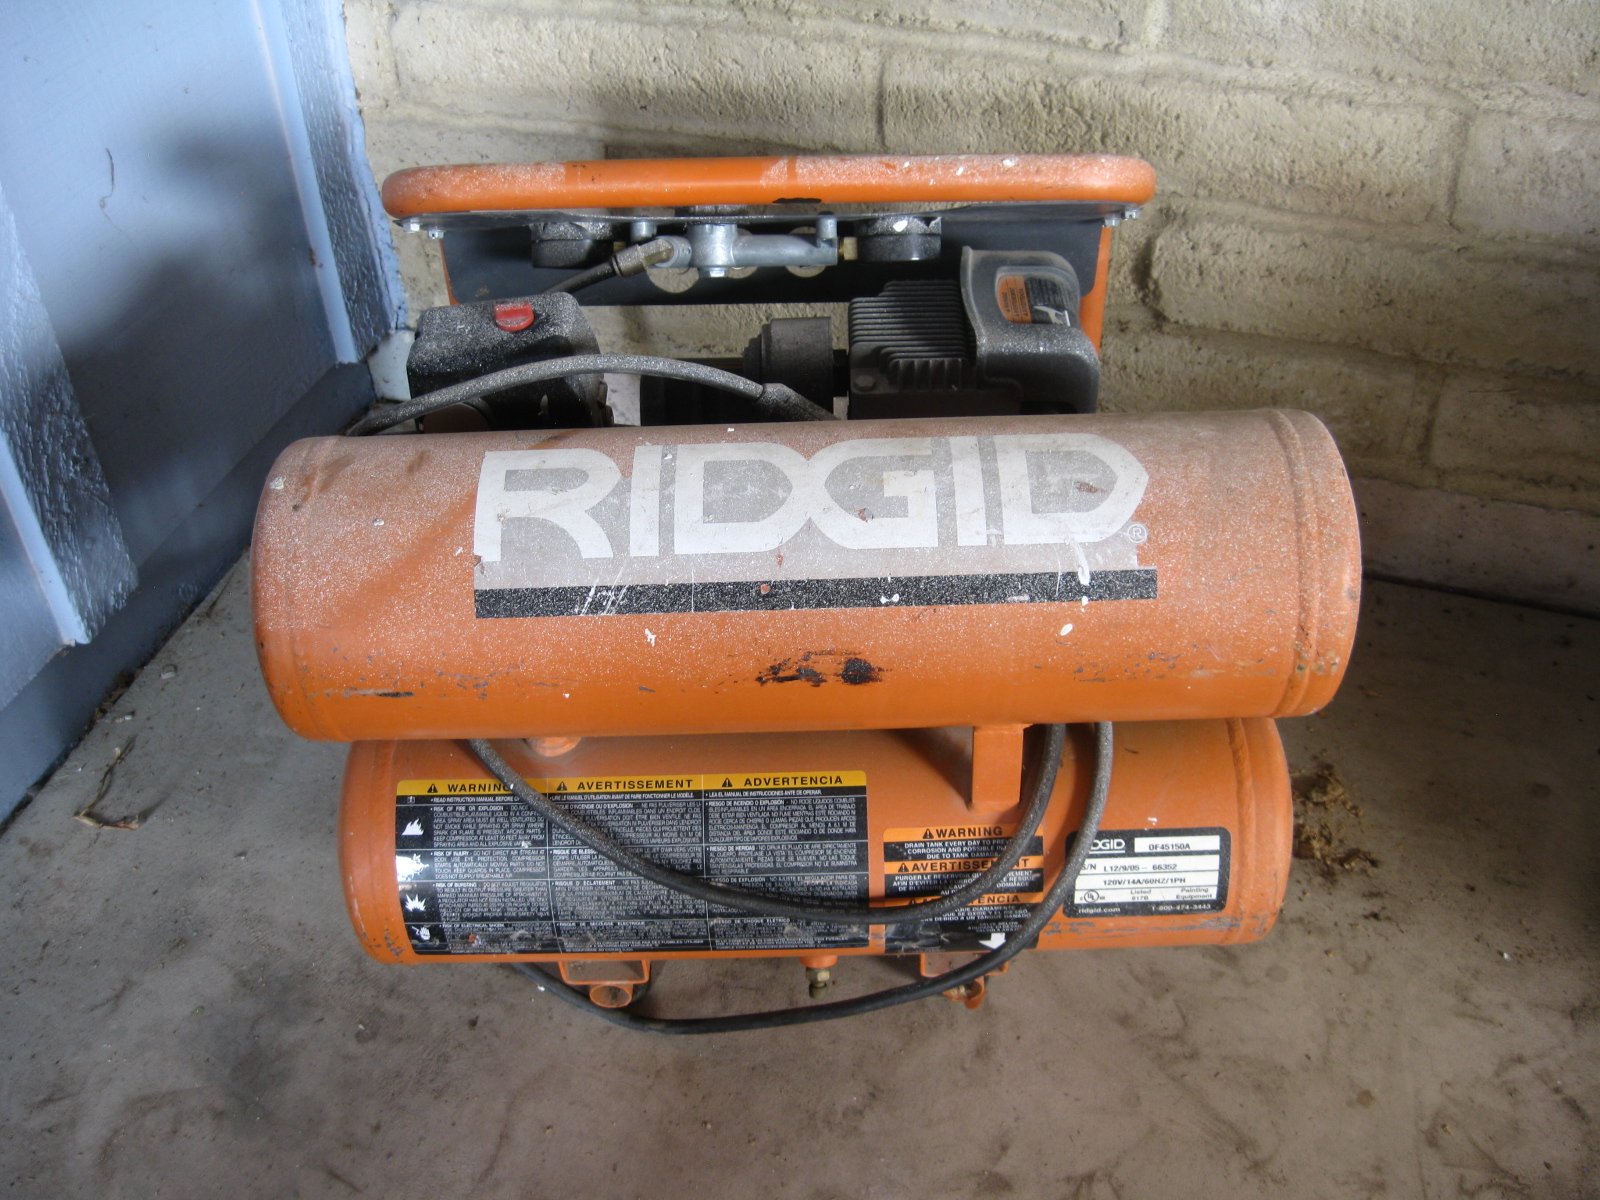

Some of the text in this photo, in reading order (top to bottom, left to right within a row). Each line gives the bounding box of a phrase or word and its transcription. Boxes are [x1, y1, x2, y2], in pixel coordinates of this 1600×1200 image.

[474, 434, 1149, 562] RIDGID
[577, 779, 693, 790] AVERTISSEMENT
[744, 776, 843, 786] ADVERTENCIA
[936, 826, 1003, 838] WARNING
[1091, 839, 1126, 850] DGID
[912, 859, 1029, 872] AVERTISSET
